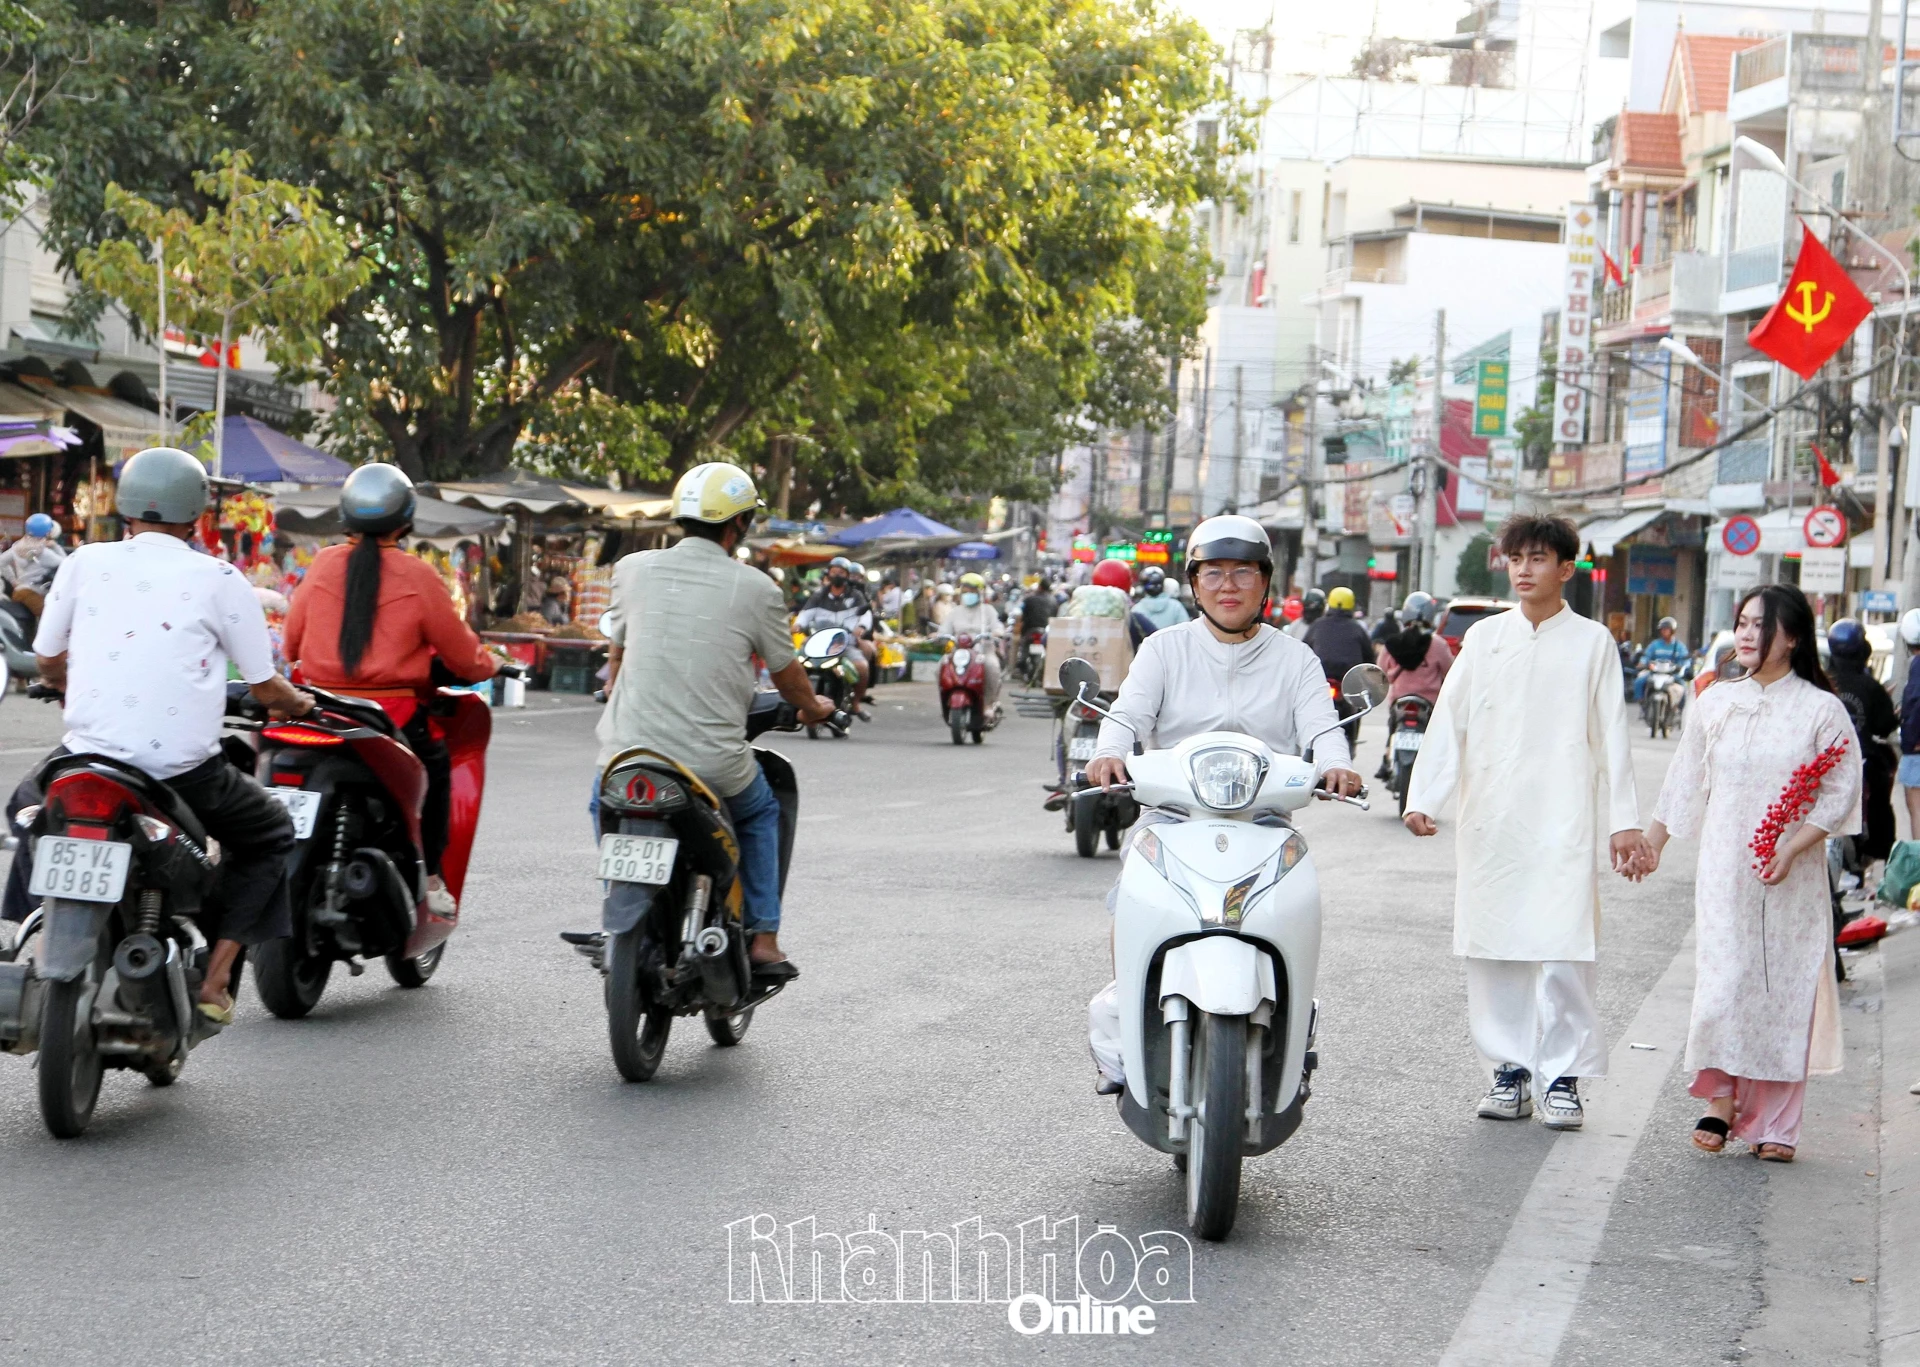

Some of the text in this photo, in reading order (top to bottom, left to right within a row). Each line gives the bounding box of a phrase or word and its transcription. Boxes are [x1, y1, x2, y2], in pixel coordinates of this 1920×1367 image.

[50, 841, 114, 869] 85-V4
[602, 857, 668, 881] 190.36
[45, 867, 112, 896] 0985
